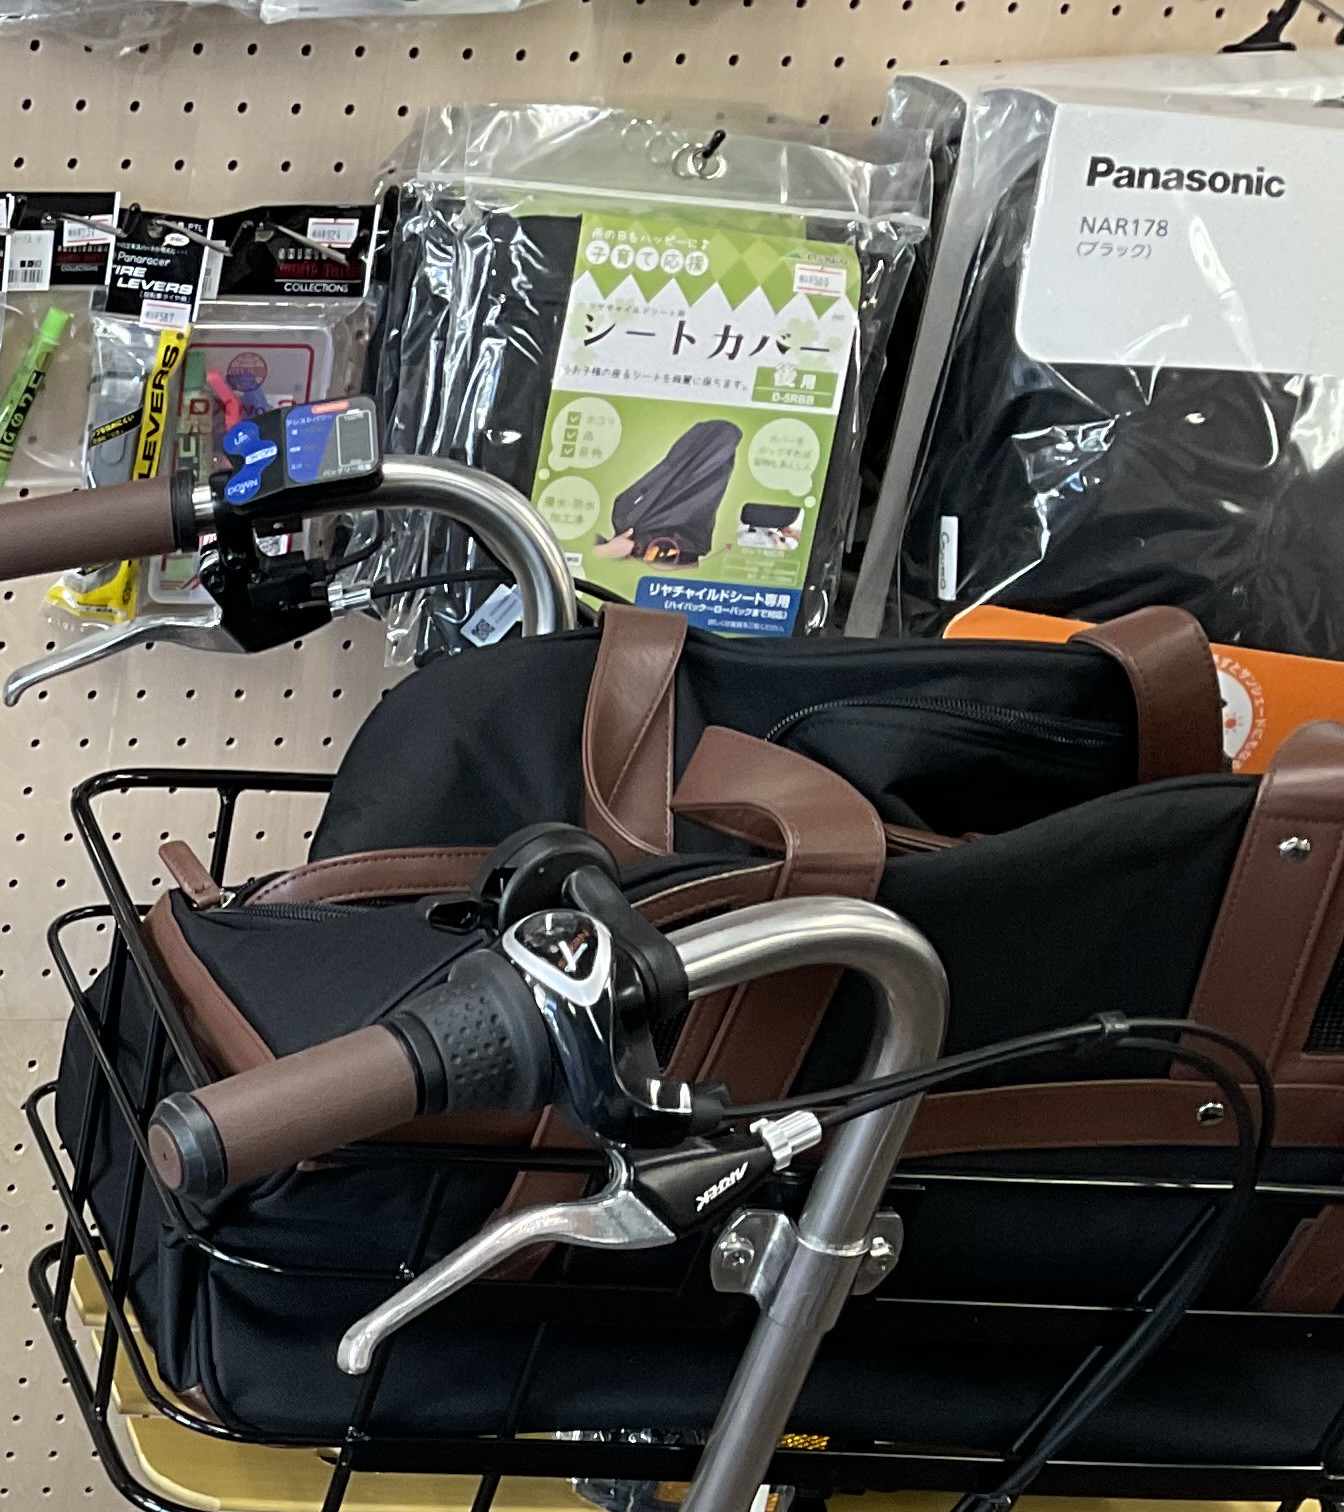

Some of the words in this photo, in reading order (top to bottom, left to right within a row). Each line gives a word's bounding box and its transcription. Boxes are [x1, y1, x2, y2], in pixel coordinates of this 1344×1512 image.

[1086, 155, 1287, 198] Panasonic
[1079, 215, 1169, 238] NAR178
[112, 265, 147, 278] IRE
[117, 251, 171, 267] Panaracer
[589, 243, 706, 275] 子育て応援
[116, 277, 194, 295] LEVERS
[283, 282, 350, 294] COLLECTIONS
[583, 313, 830, 361] シートカバー
[138, 344, 180, 479] LEVERS
[649, 582, 792, 610] リヤチャイルドシート専用
